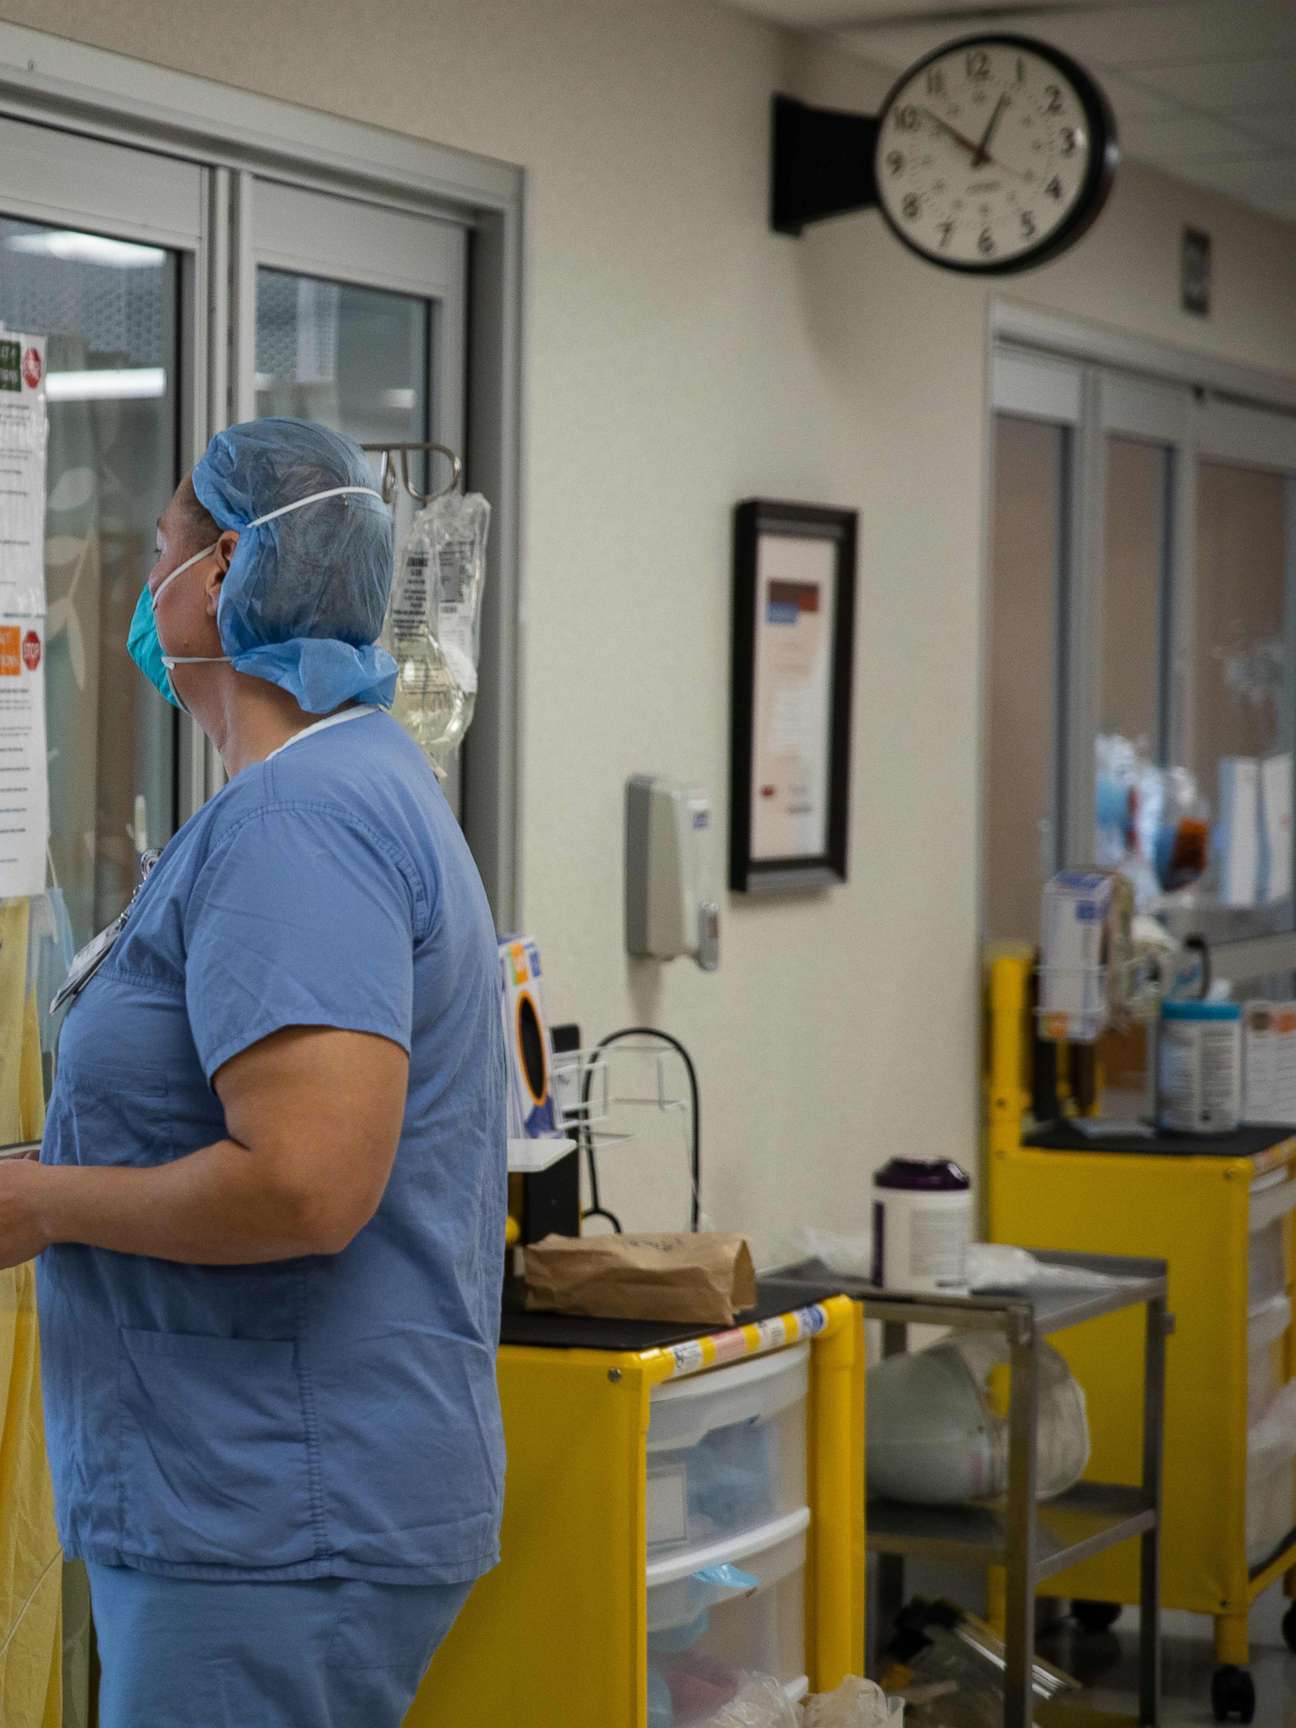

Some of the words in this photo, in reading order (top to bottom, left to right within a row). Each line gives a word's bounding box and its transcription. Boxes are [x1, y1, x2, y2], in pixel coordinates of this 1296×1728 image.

[966, 52, 990, 80] 12
[1016, 56, 1024, 82] 1
[927, 68, 944, 94] 11
[1045, 84, 1063, 115] 2
[894, 105, 917, 131] 10
[1060, 126, 1075, 157] 3
[887, 151, 904, 176] 9
[1045, 174, 1062, 198] 4
[903, 192, 919, 219] 8
[935, 218, 953, 247] 7
[1021, 210, 1036, 236] 5
[977, 225, 994, 252] 6
